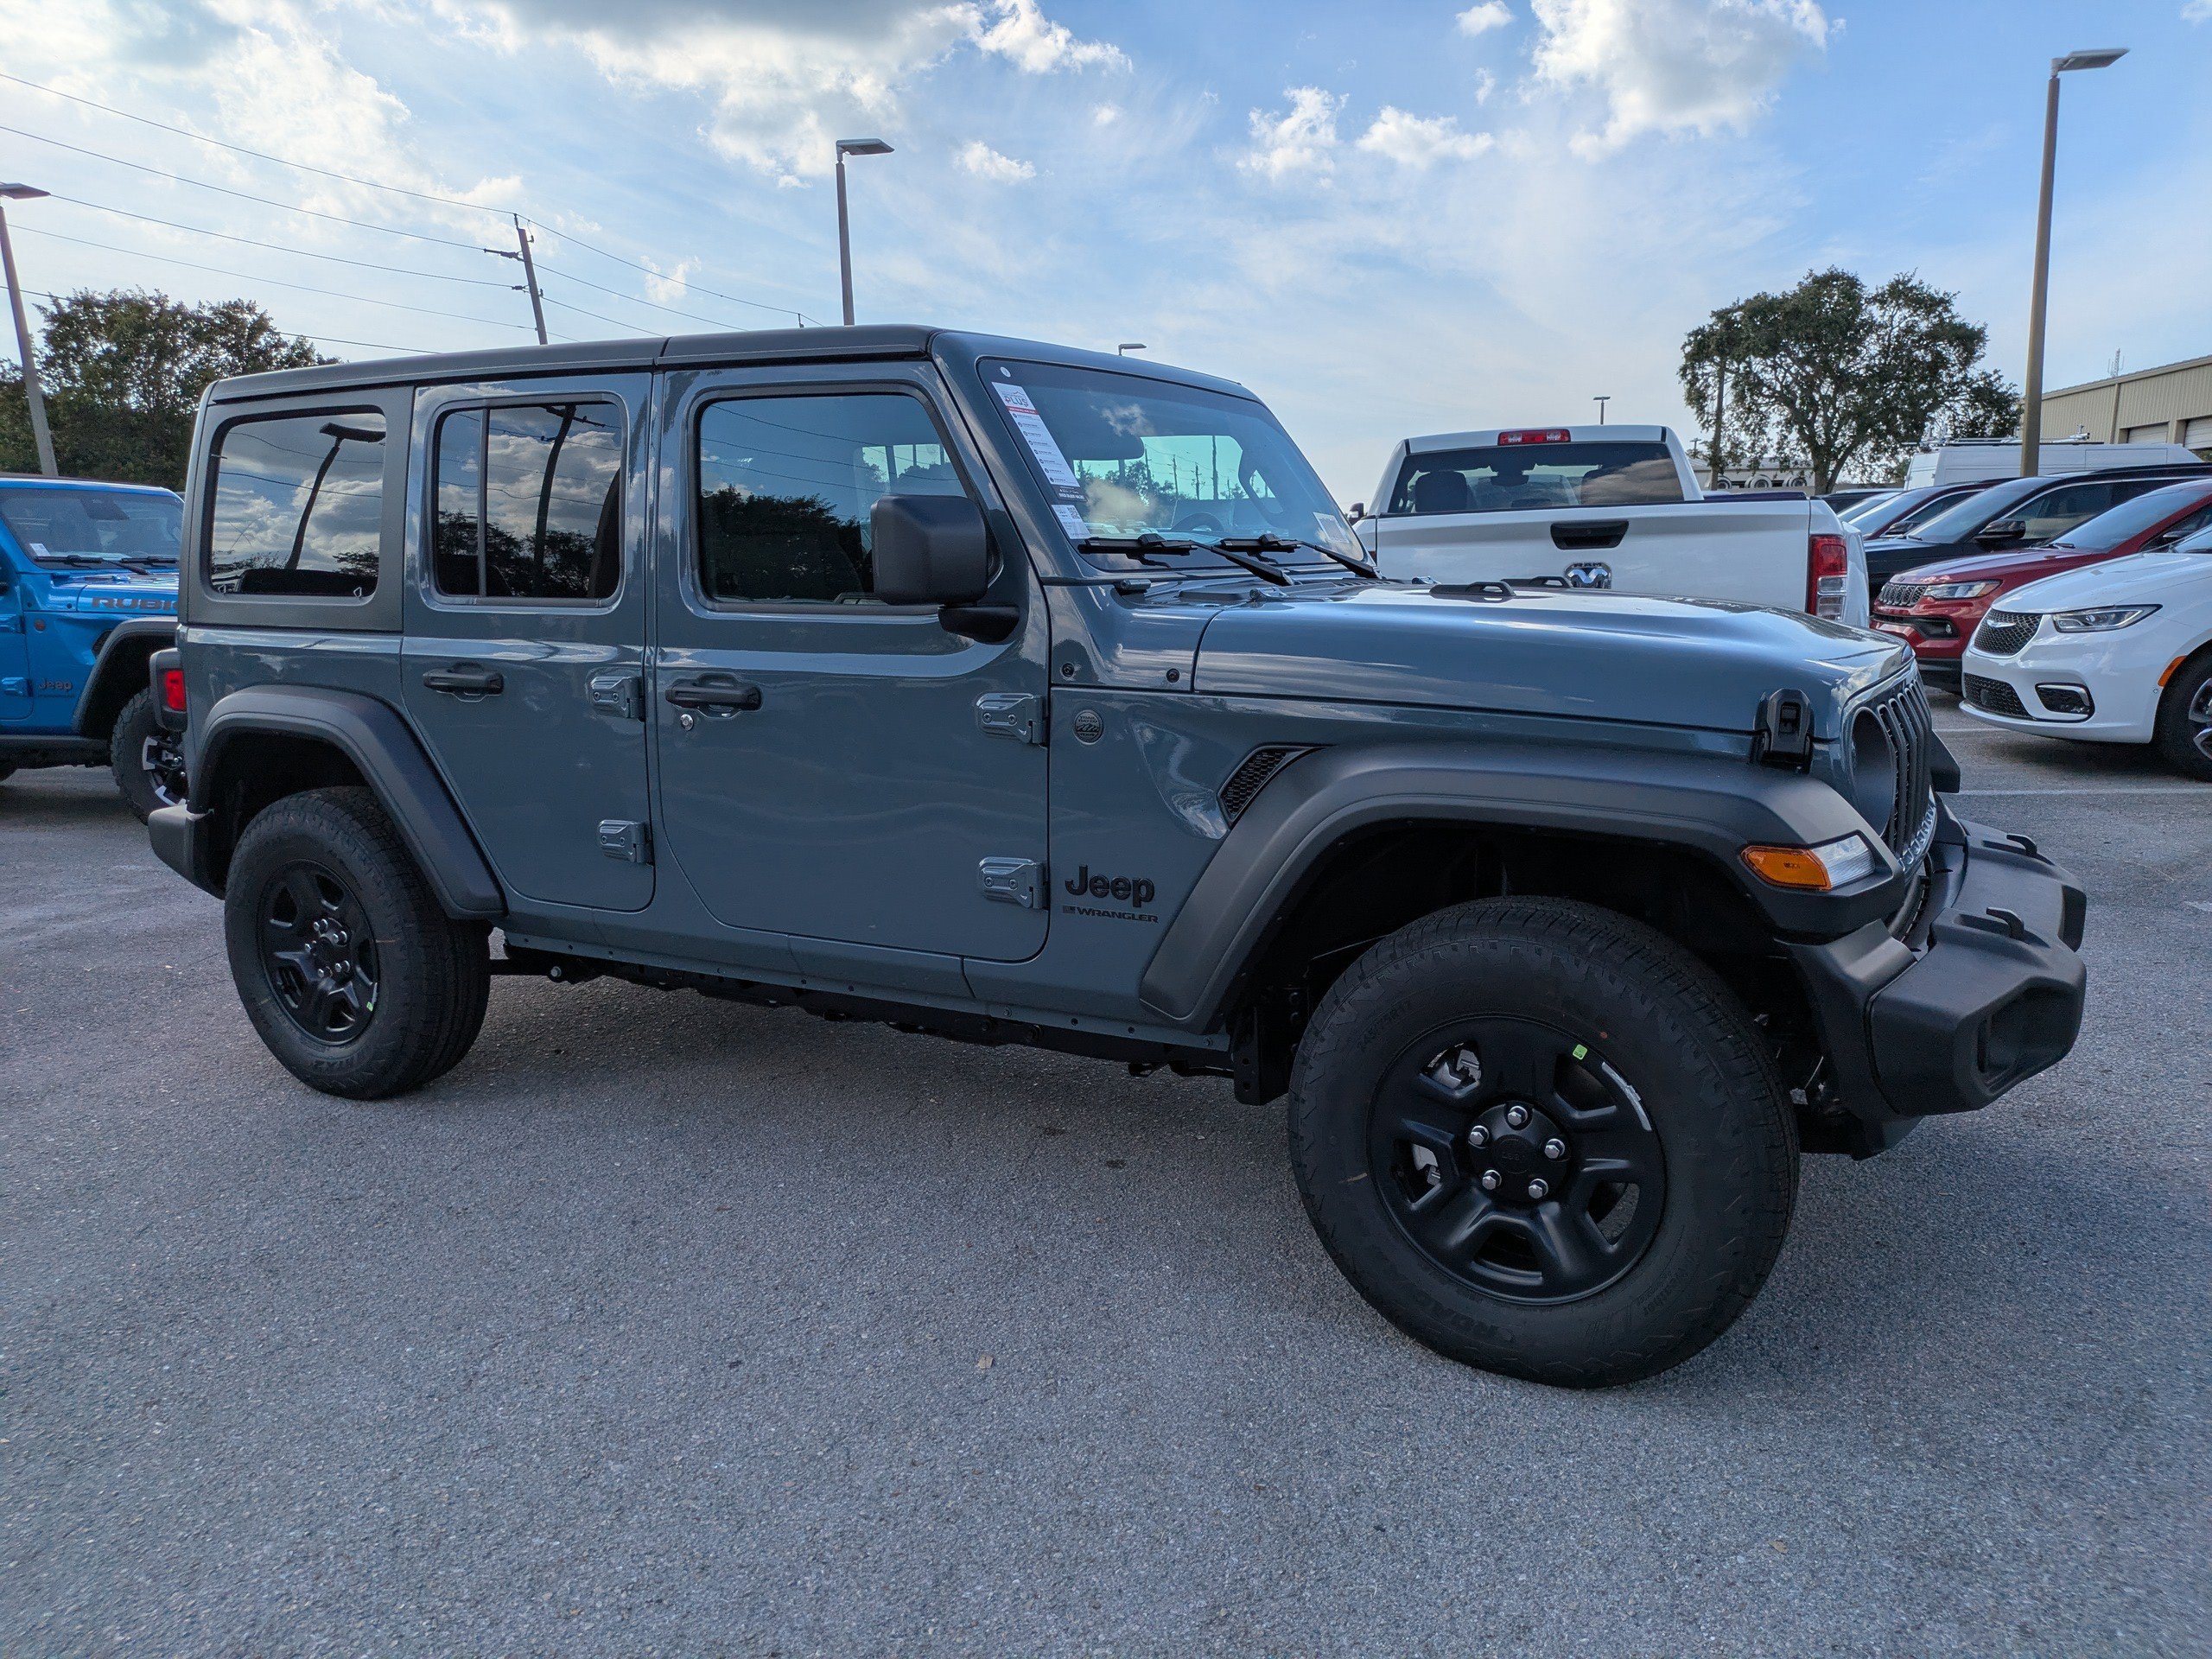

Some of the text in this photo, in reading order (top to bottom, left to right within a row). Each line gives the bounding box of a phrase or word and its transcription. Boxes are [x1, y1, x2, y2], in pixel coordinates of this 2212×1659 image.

[38, 678, 73, 692] Jeep
[1065, 864, 1155, 907] Jeep
[1077, 906, 1160, 923] WRANGLER
